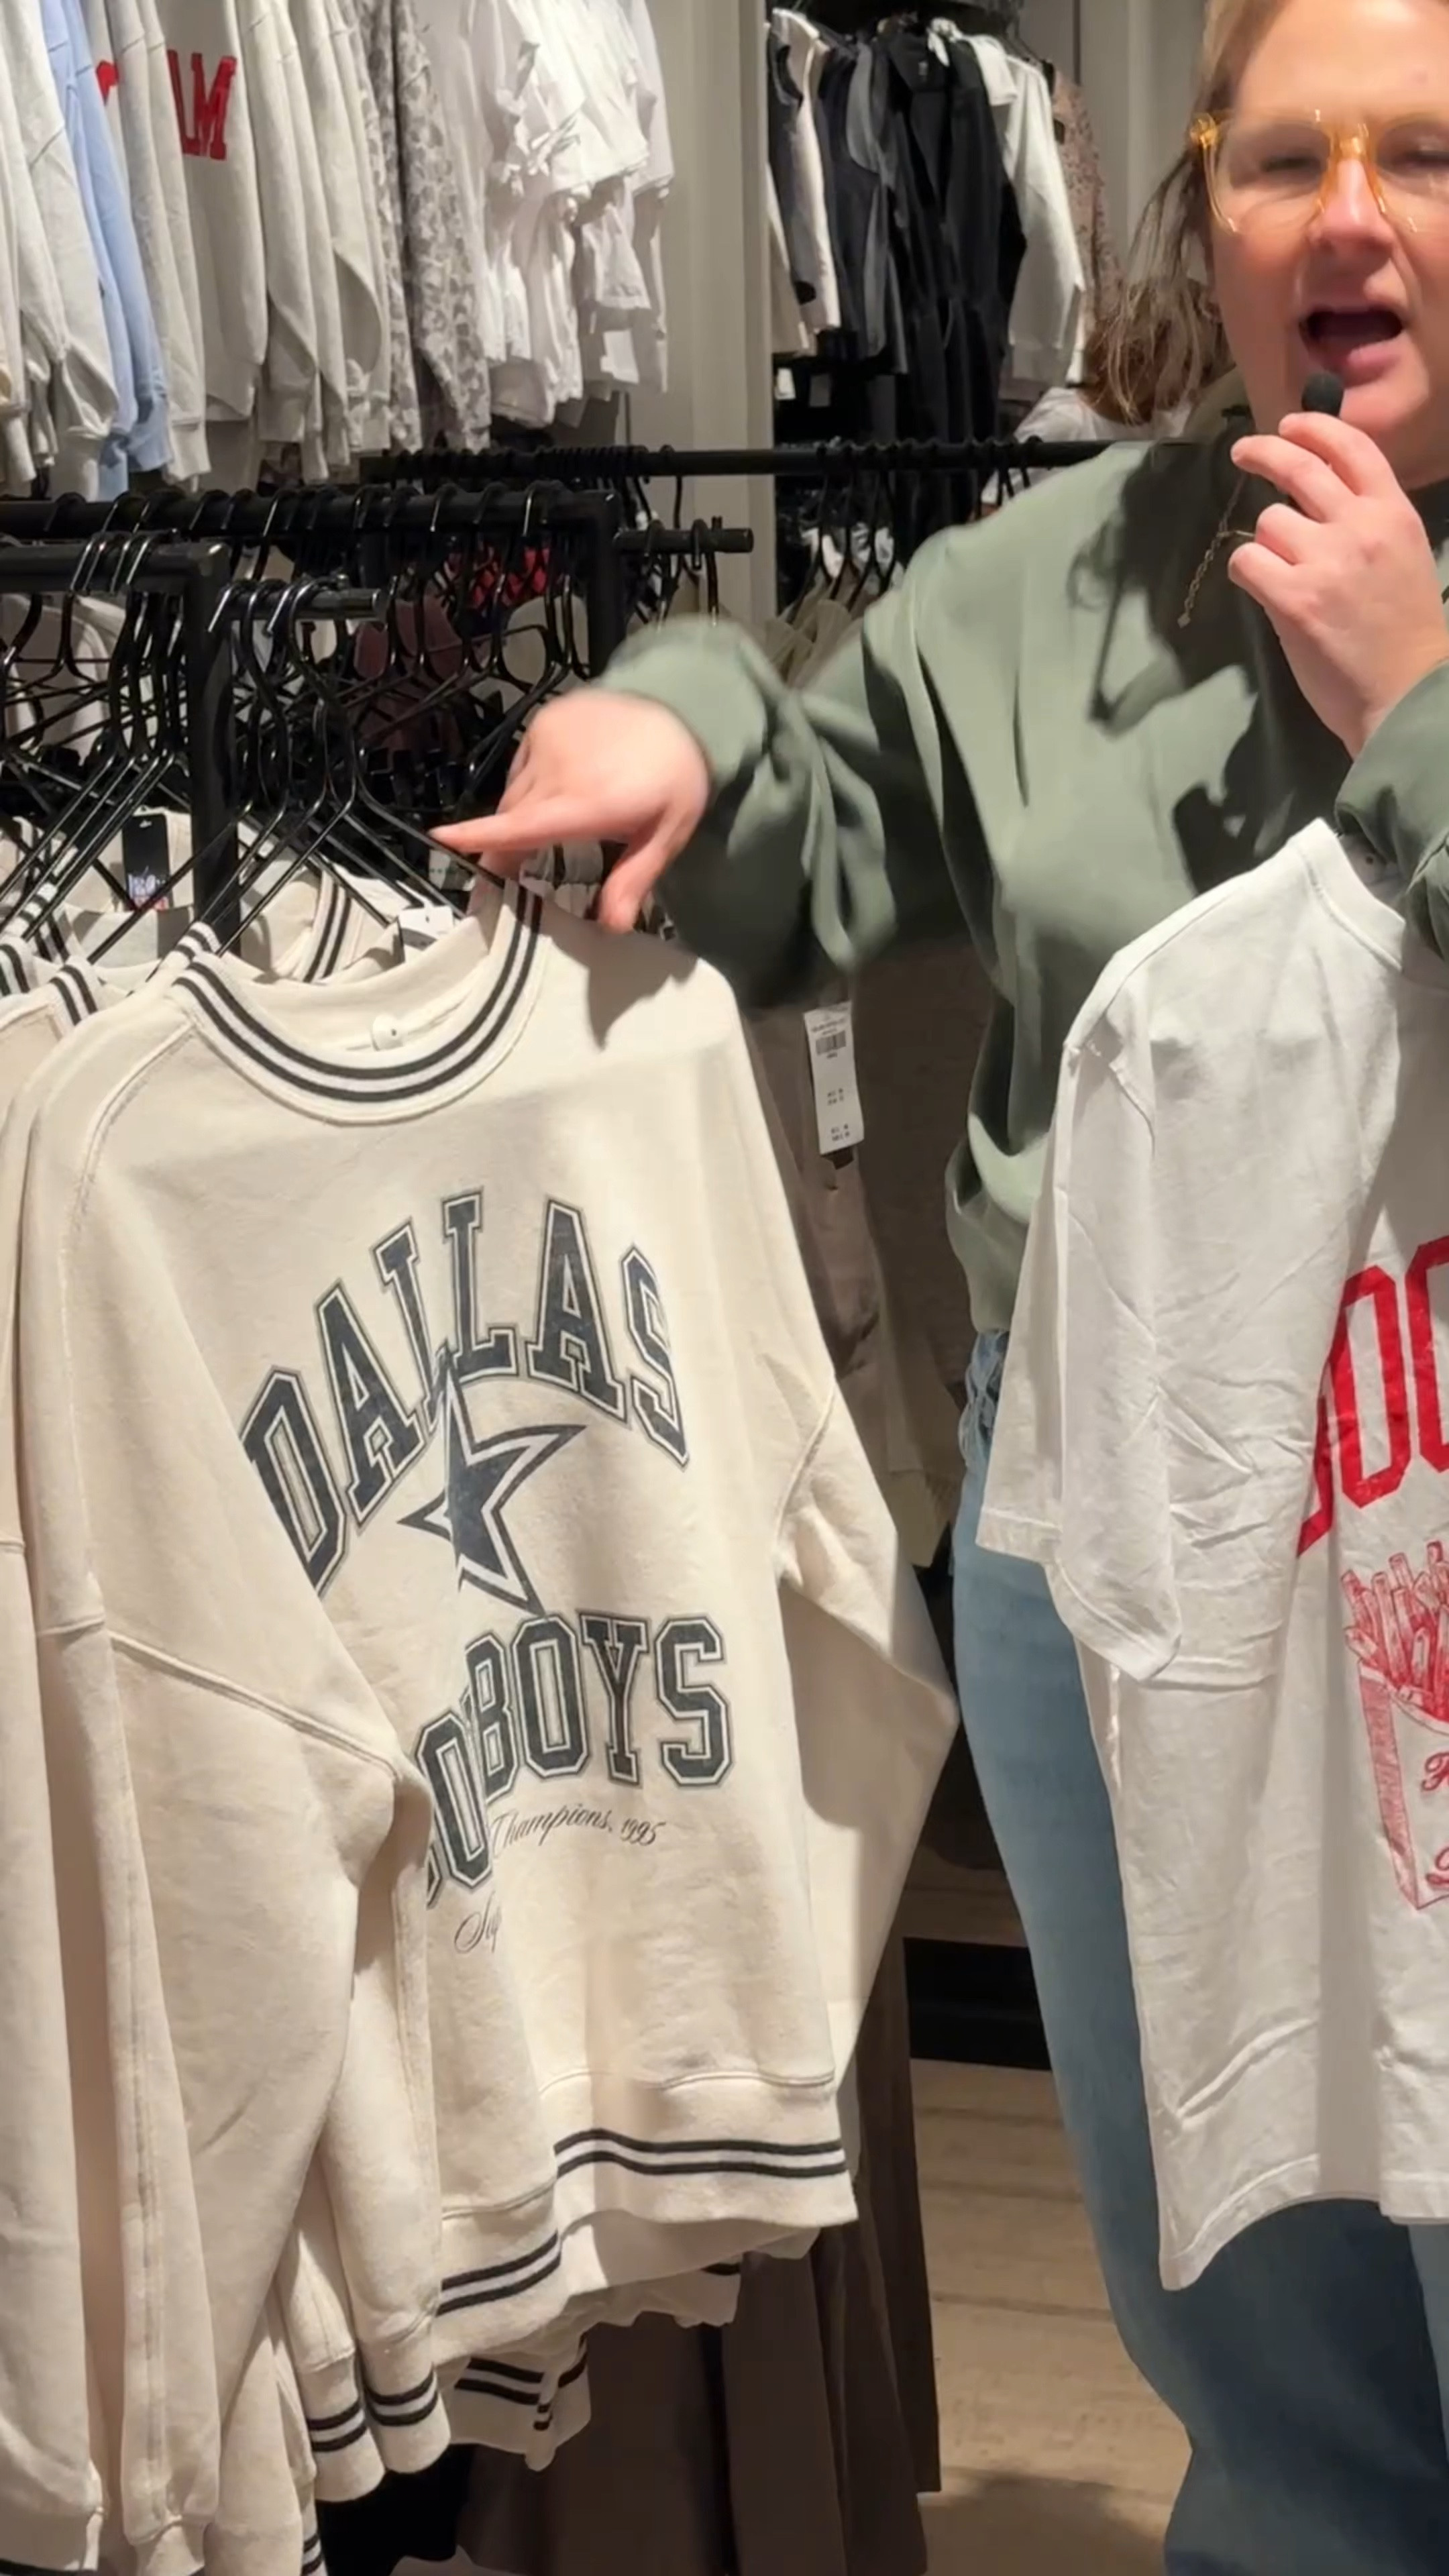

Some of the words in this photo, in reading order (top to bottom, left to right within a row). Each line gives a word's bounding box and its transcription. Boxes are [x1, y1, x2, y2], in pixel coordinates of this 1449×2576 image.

[237, 1187, 690, 1597] DALLAS
[426, 1609, 733, 1909] OBOYS
[620, 1817, 667, 1846] 1995
